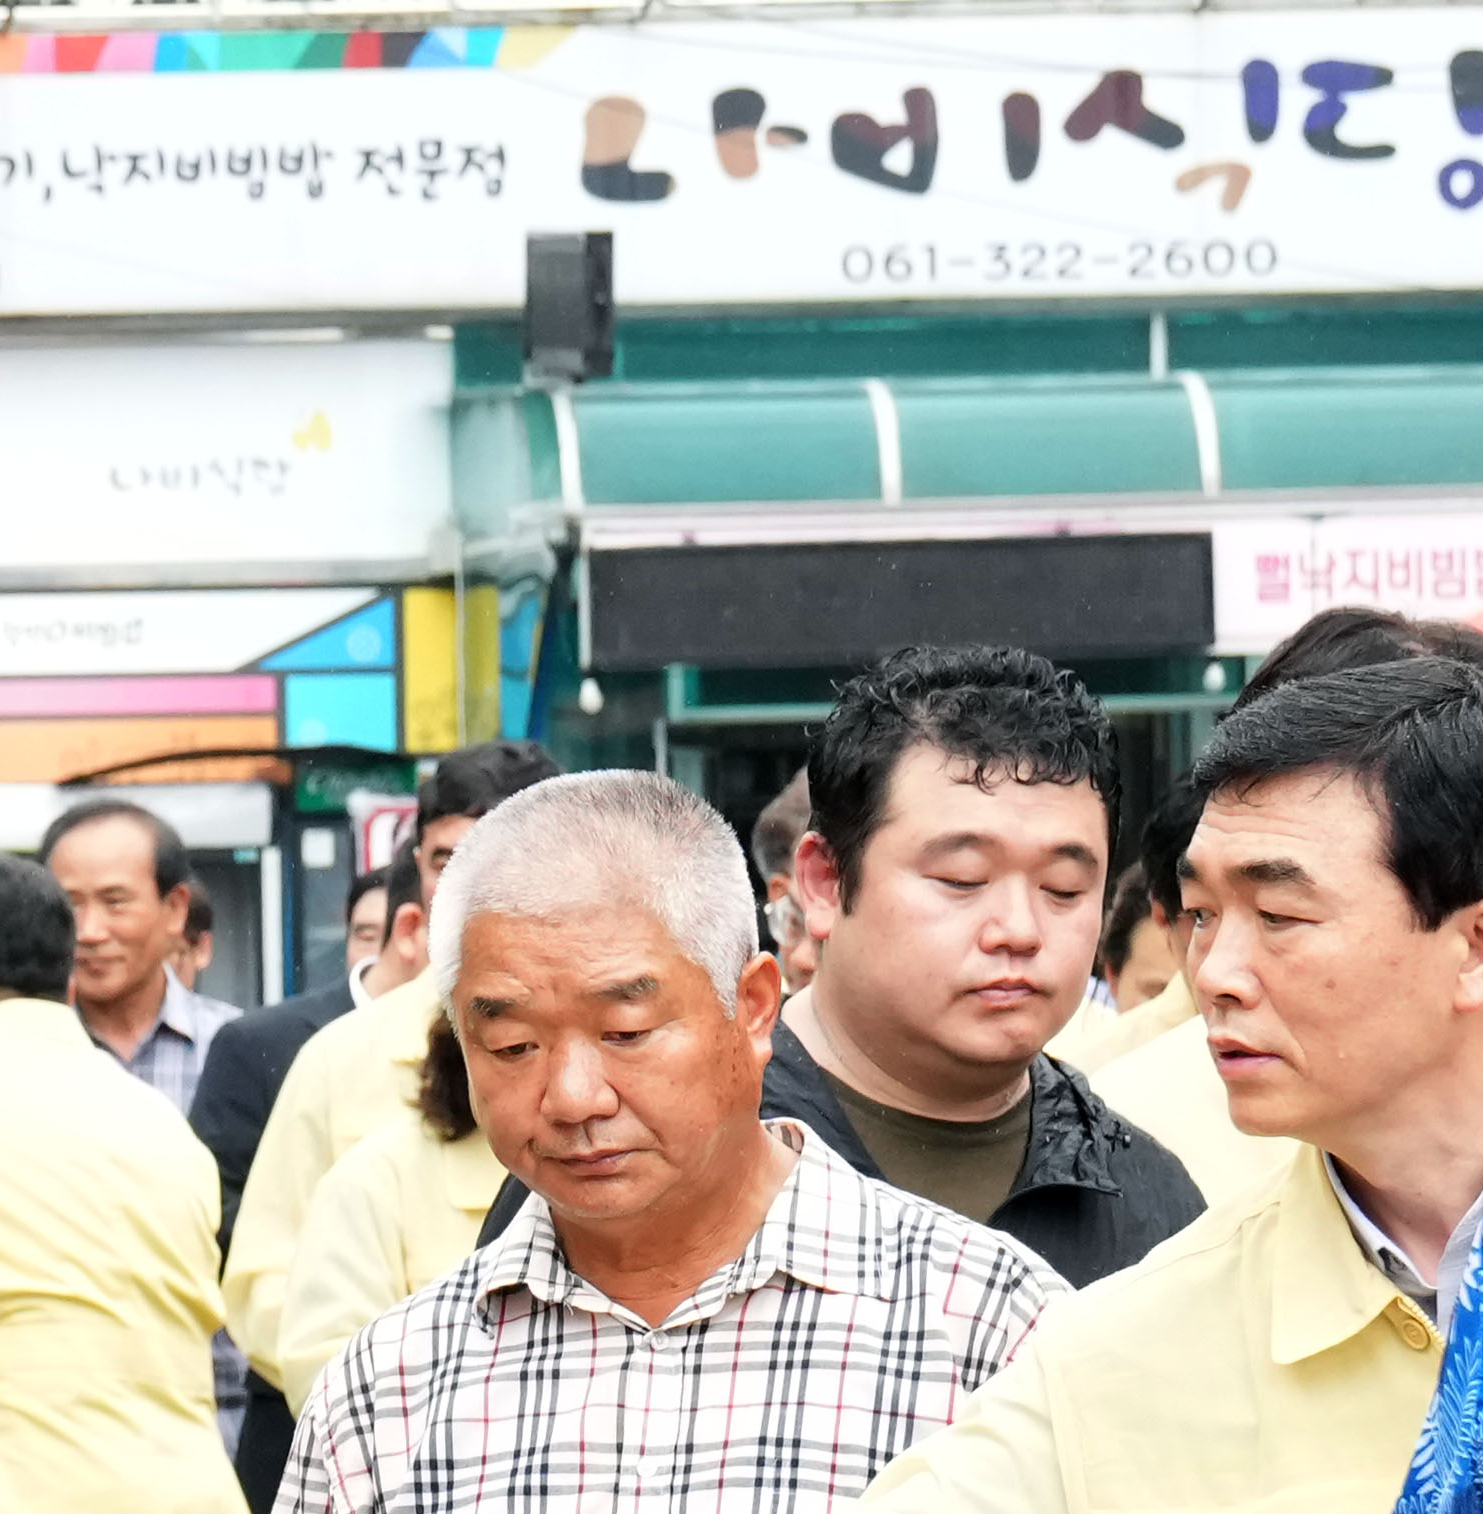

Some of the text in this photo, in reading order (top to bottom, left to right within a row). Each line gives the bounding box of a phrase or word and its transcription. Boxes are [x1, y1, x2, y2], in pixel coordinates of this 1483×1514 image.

[356, 139, 508, 200] 전문점
[841, 239, 1279, 284] 061-322-2600
[1254, 546, 1483, 604] 뻘낙지비빔
